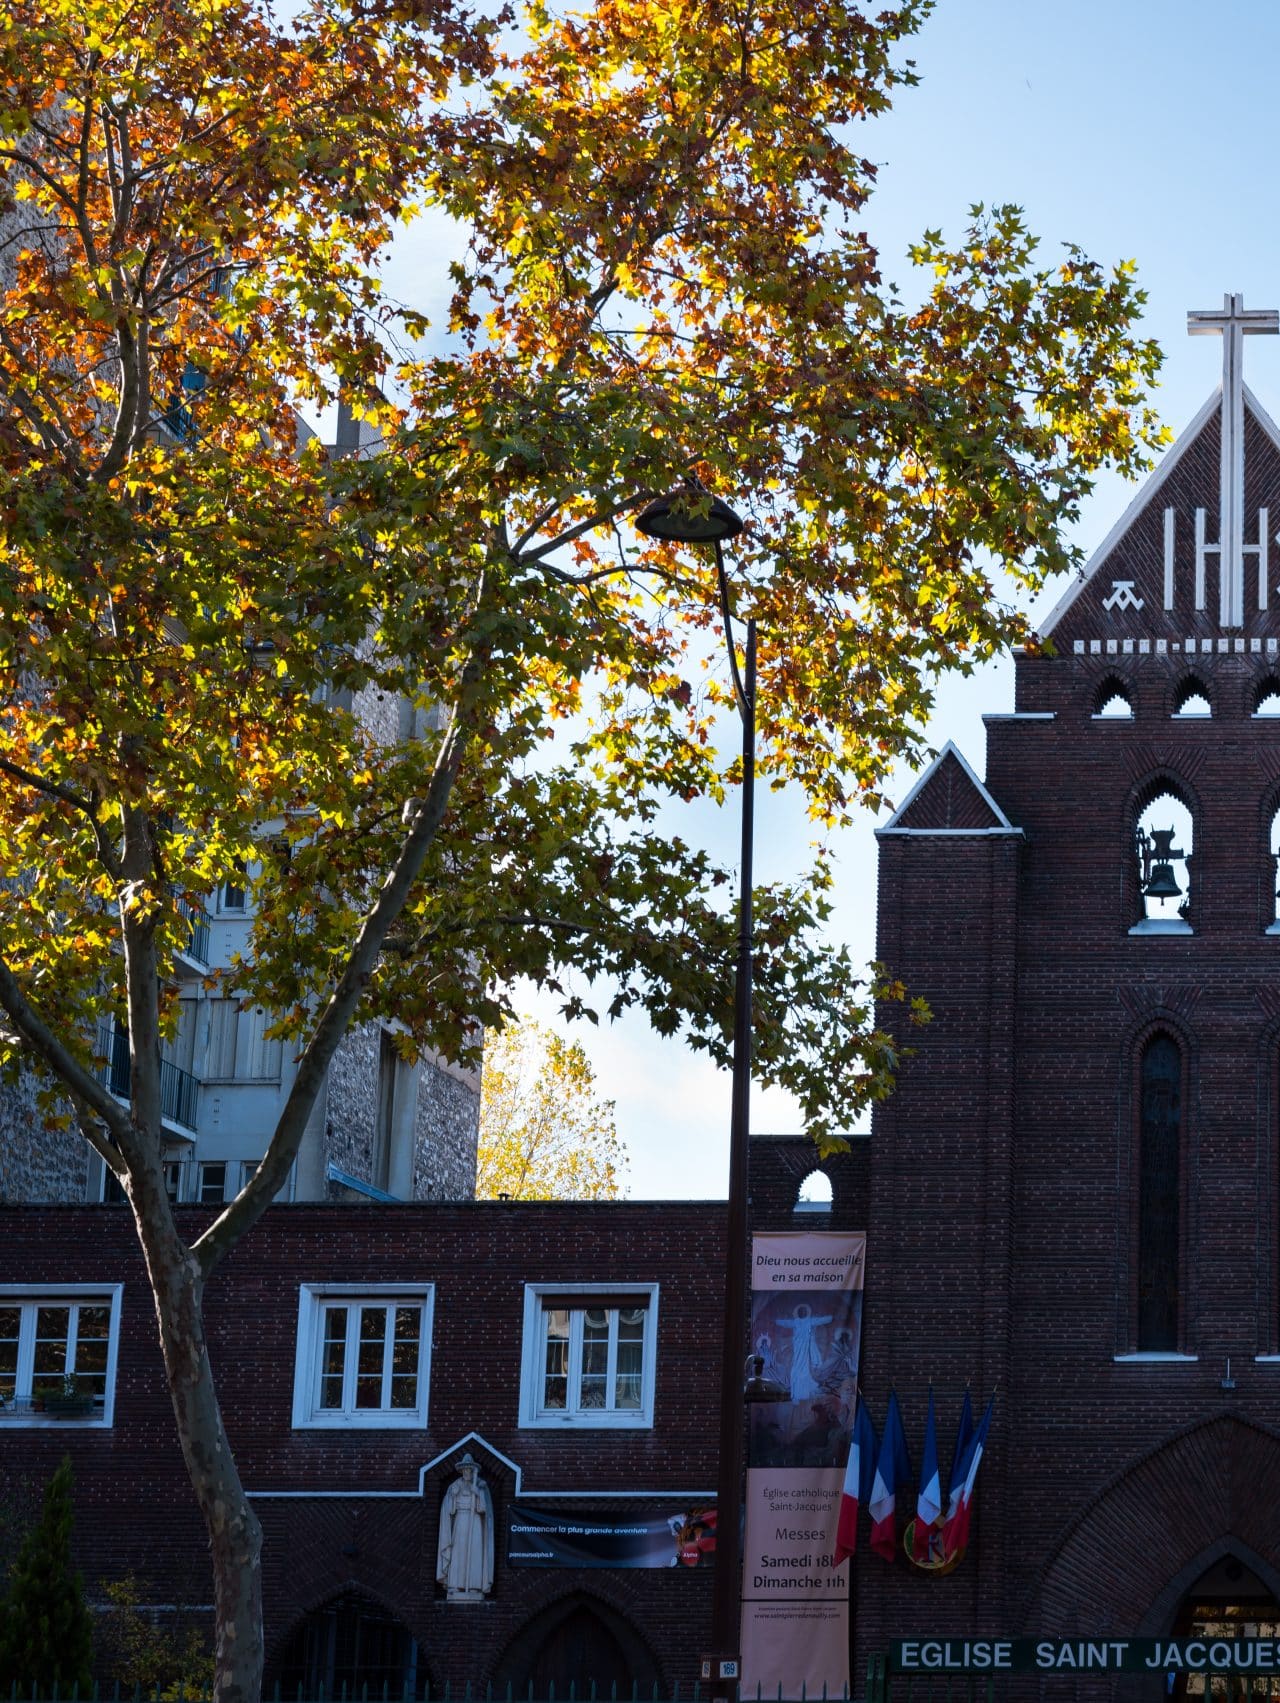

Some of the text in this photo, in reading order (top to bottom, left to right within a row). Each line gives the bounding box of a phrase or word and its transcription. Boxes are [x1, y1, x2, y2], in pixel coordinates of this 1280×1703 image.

[756, 1255, 862, 1266] Dieu nous accueille
[772, 1272, 844, 1282] en sa maison
[763, 1485, 840, 1500] Église catholique
[769, 1502, 832, 1513] Saint-Jacques
[510, 1524, 557, 1533] Commencer
[558, 1525, 566, 1533] la
[567, 1526, 583, 1534] plus
[585, 1527, 613, 1535] grande
[776, 1528, 826, 1541] Messes
[761, 1554, 811, 1568] Samedi
[753, 1575, 845, 1588] Dimanche 11h
[901, 1641, 1012, 1668] EGLISE
[1035, 1641, 1129, 1668] SAINT
